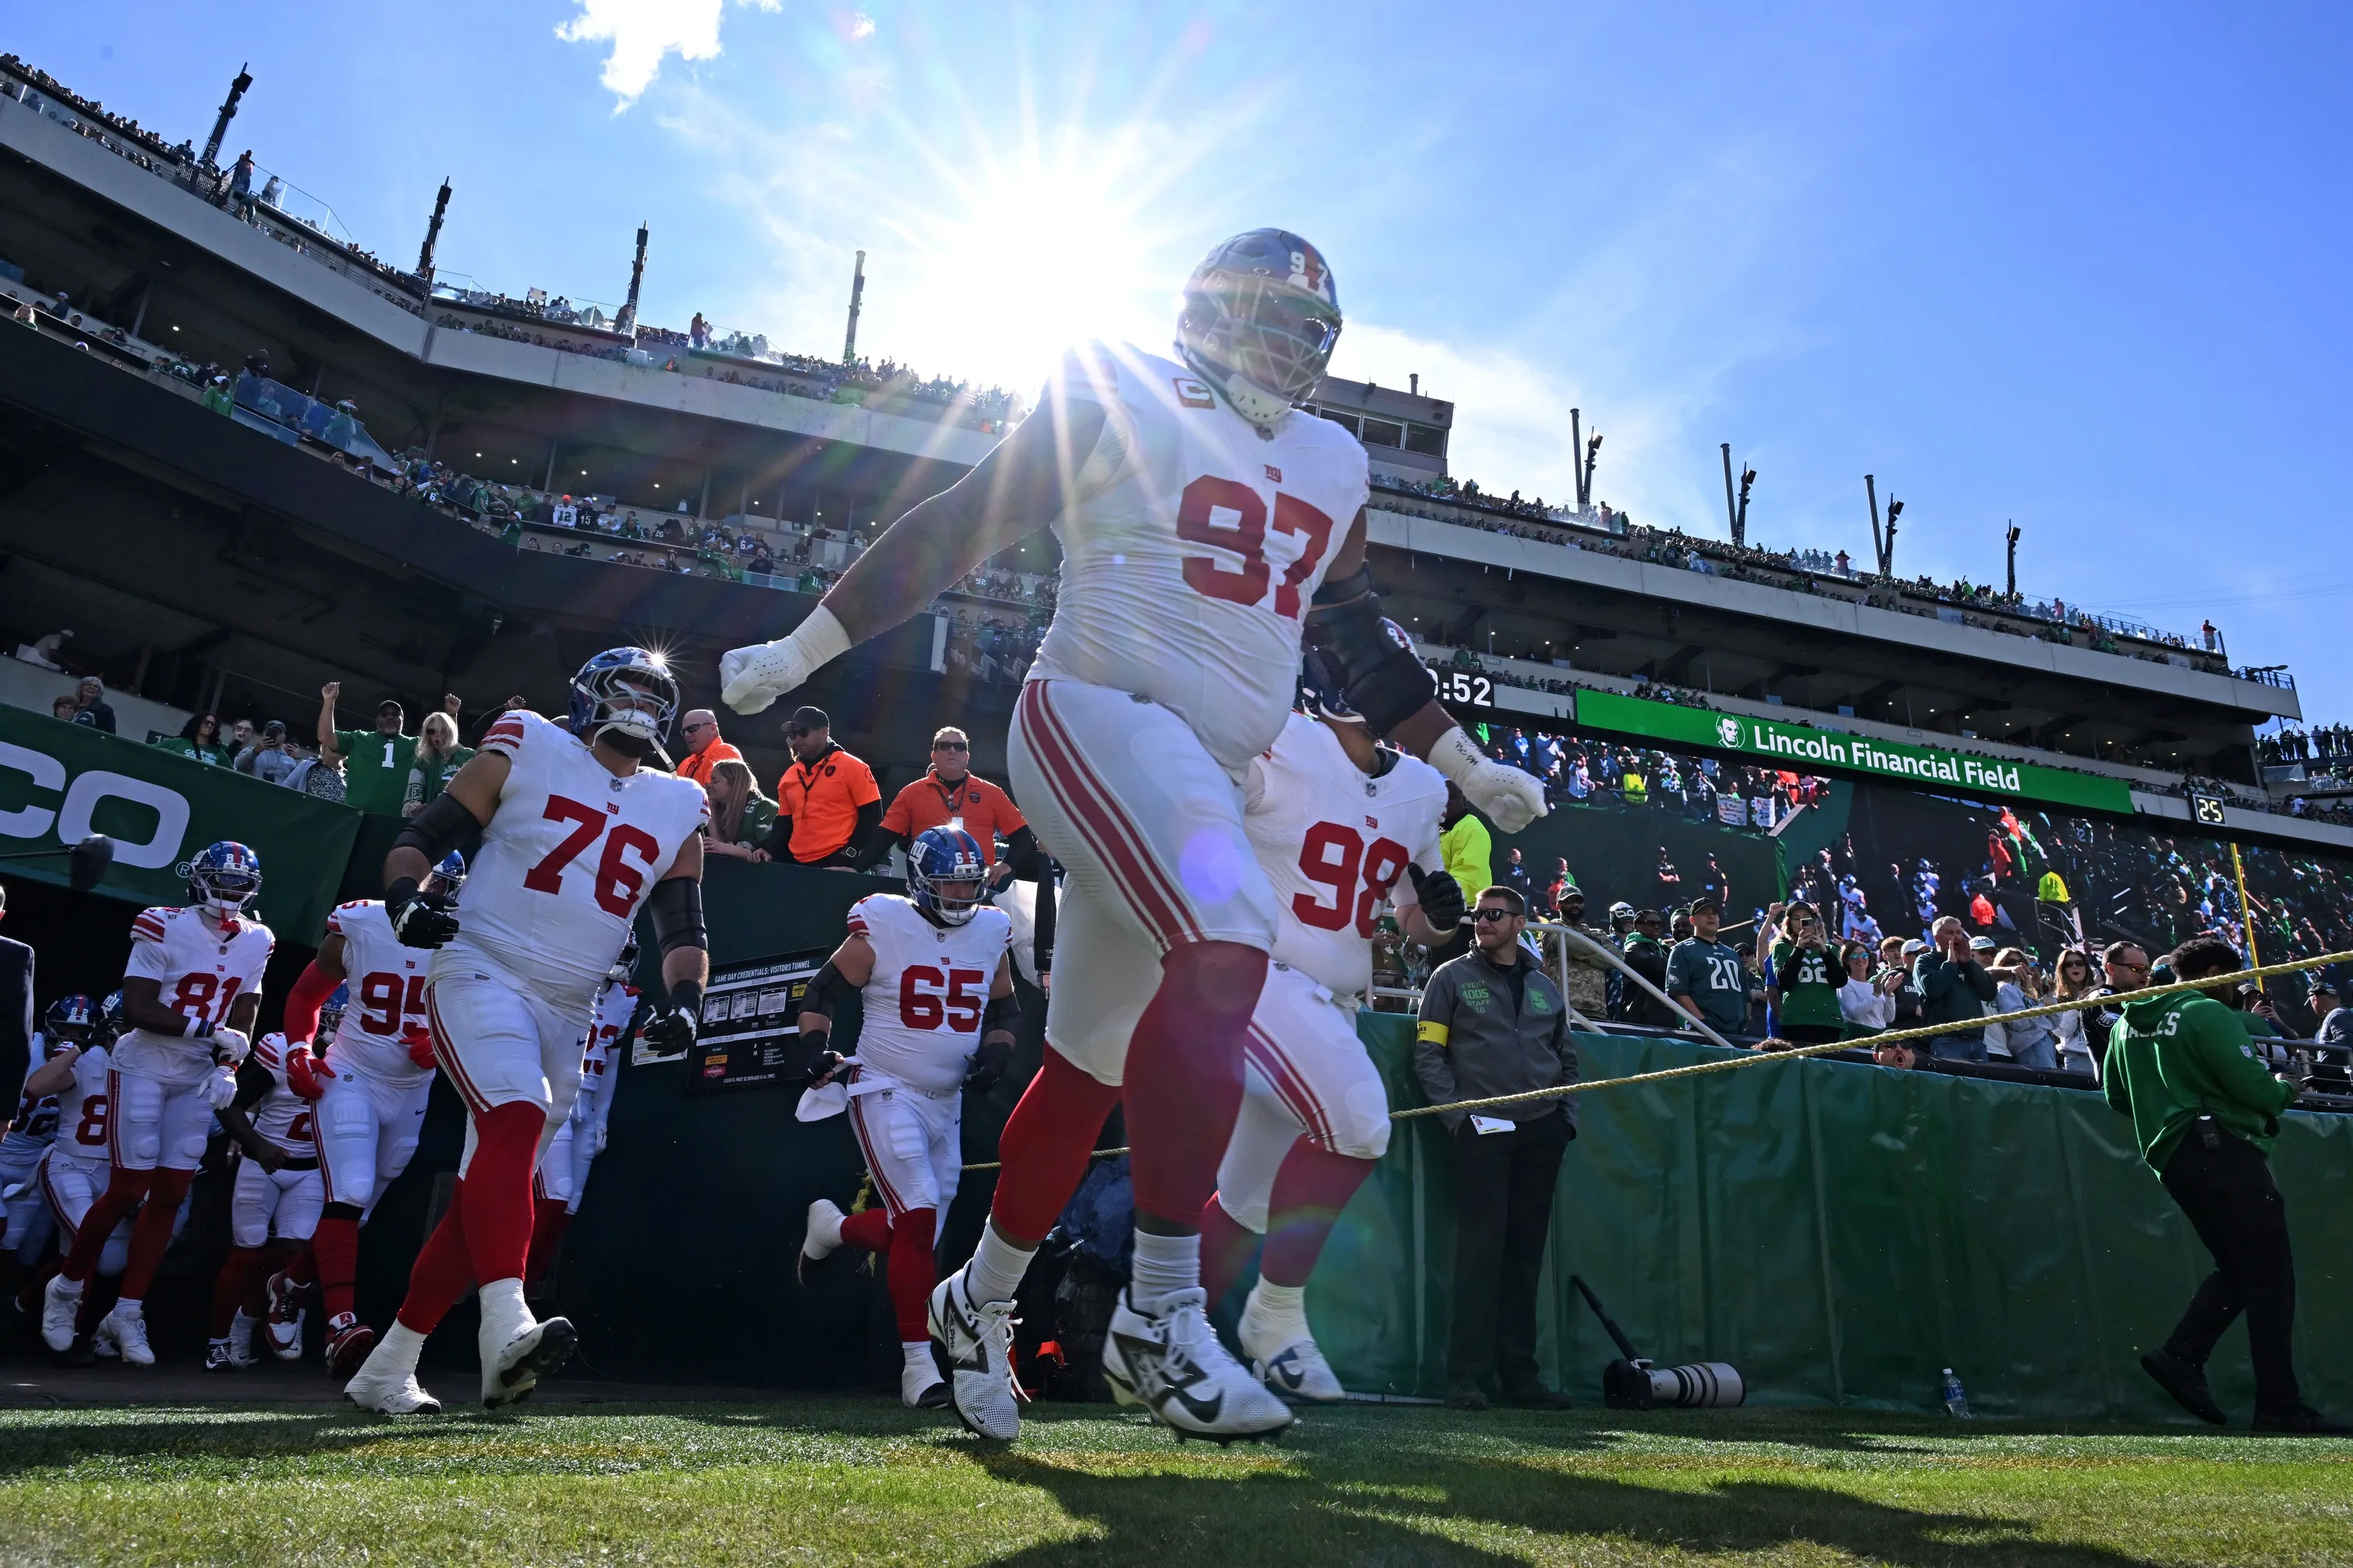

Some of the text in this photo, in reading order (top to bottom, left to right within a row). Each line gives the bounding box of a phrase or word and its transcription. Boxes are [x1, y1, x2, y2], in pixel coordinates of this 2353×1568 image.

[559, 510, 572, 522] 12
[580, 515, 591, 526] 15
[740, 540, 746, 550] 6
[1176, 474, 1334, 620] 97
[381, 742, 395, 769] 1
[1754, 725, 2021, 791] Lincoln Financial Field
[2196, 798, 2222, 823] 25
[226, 853, 246, 865] 81
[523, 794, 661, 919] 76
[955, 851, 976, 865] 65
[1292, 820, 1409, 940] 98
[714, 975, 727, 983] GAME
[737, 968, 769, 979] CREDENTIALS:
[770, 964, 791, 974] VISITORS
[792, 960, 810, 970] TUNNEL
[1461, 980, 1486, 989] EVENT
[1706, 956, 1742, 993] 20
[170, 972, 243, 1025] 81
[360, 972, 430, 1041] 95
[899, 965, 984, 1033] 65
[70, 1007, 89, 1017] 82
